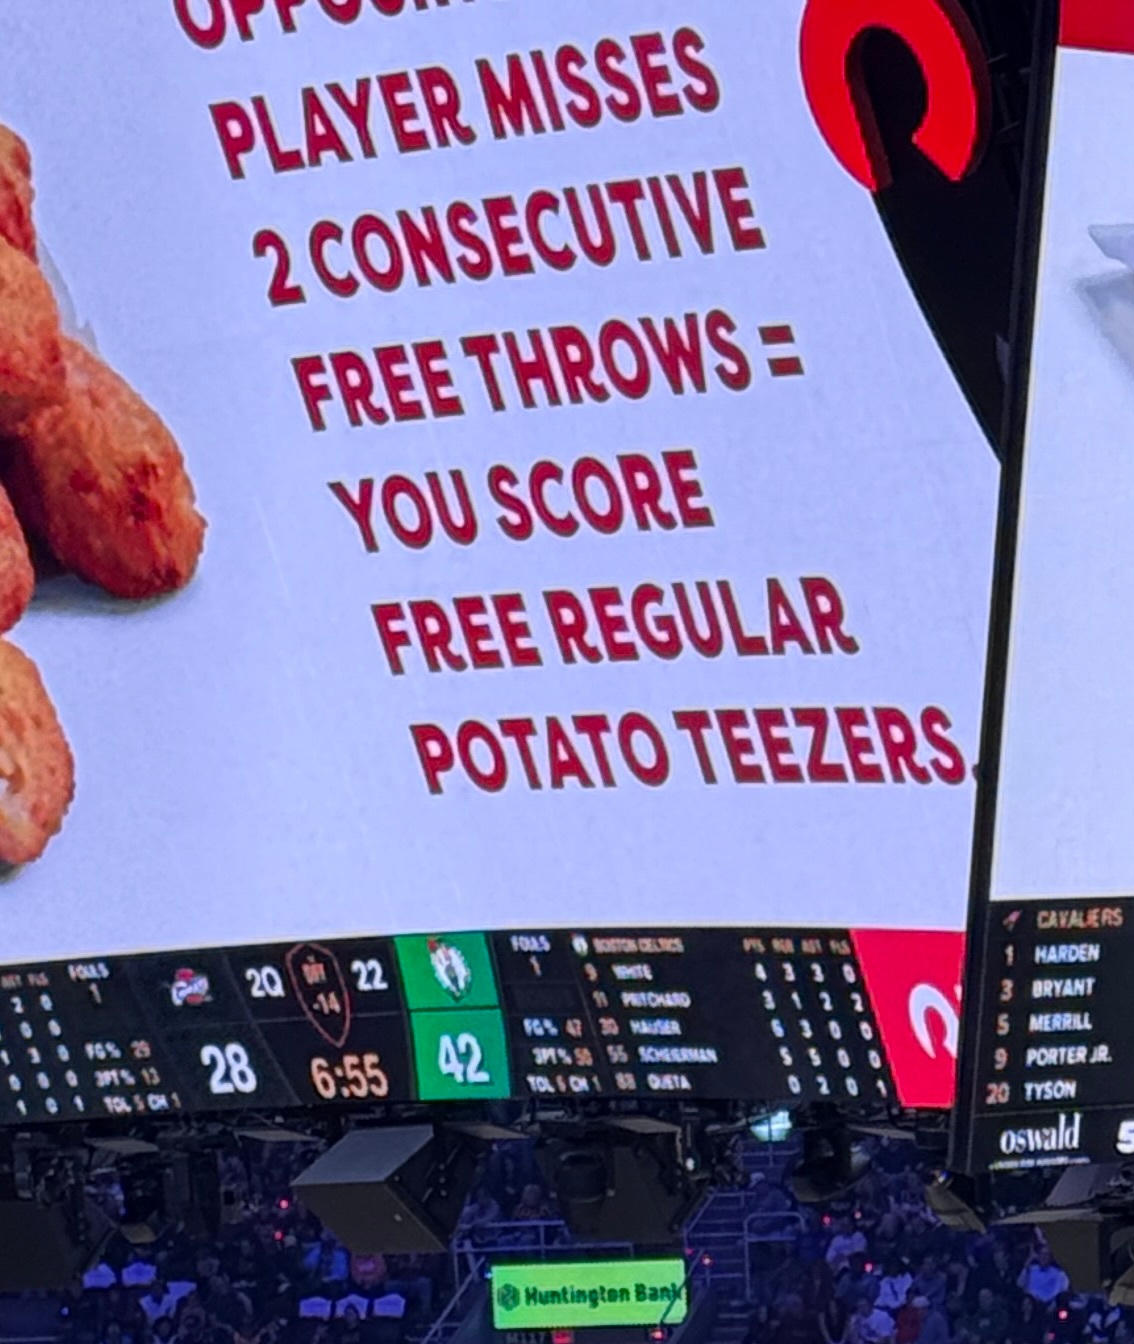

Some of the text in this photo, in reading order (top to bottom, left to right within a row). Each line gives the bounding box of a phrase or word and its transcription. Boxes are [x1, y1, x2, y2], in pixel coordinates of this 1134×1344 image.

[209, 27, 720, 181] PLAYER MISSES
[254, 166, 766, 306] 2 CONSECUTIVE
[291, 341, 465, 431] FREE
[459, 310, 752, 410] THROWS
[328, 449, 715, 553] YOU SCORE
[371, 577, 859, 676] FREE REGULAR
[410, 707, 978, 795] POTATO TEEZERS.
[1037, 910, 1123, 929] CAVALIERS
[1034, 944, 1101, 963] HARDEN
[245, 966, 286, 998] 2Q
[351, 960, 388, 991] 22
[1032, 977, 1096, 998] BRYANT
[1029, 1012, 1092, 1031] MERRILL
[201, 1043, 258, 1094] 28
[311, 1052, 389, 1098] 6:55
[437, 1033, 490, 1084] 42
[1026, 1044, 1086, 1066] PORTER
[1025, 1080, 1076, 1100] TYSON
[1000, 1113, 1081, 1155] oswald
[525, 1283, 684, 1308] Huntington Bank
